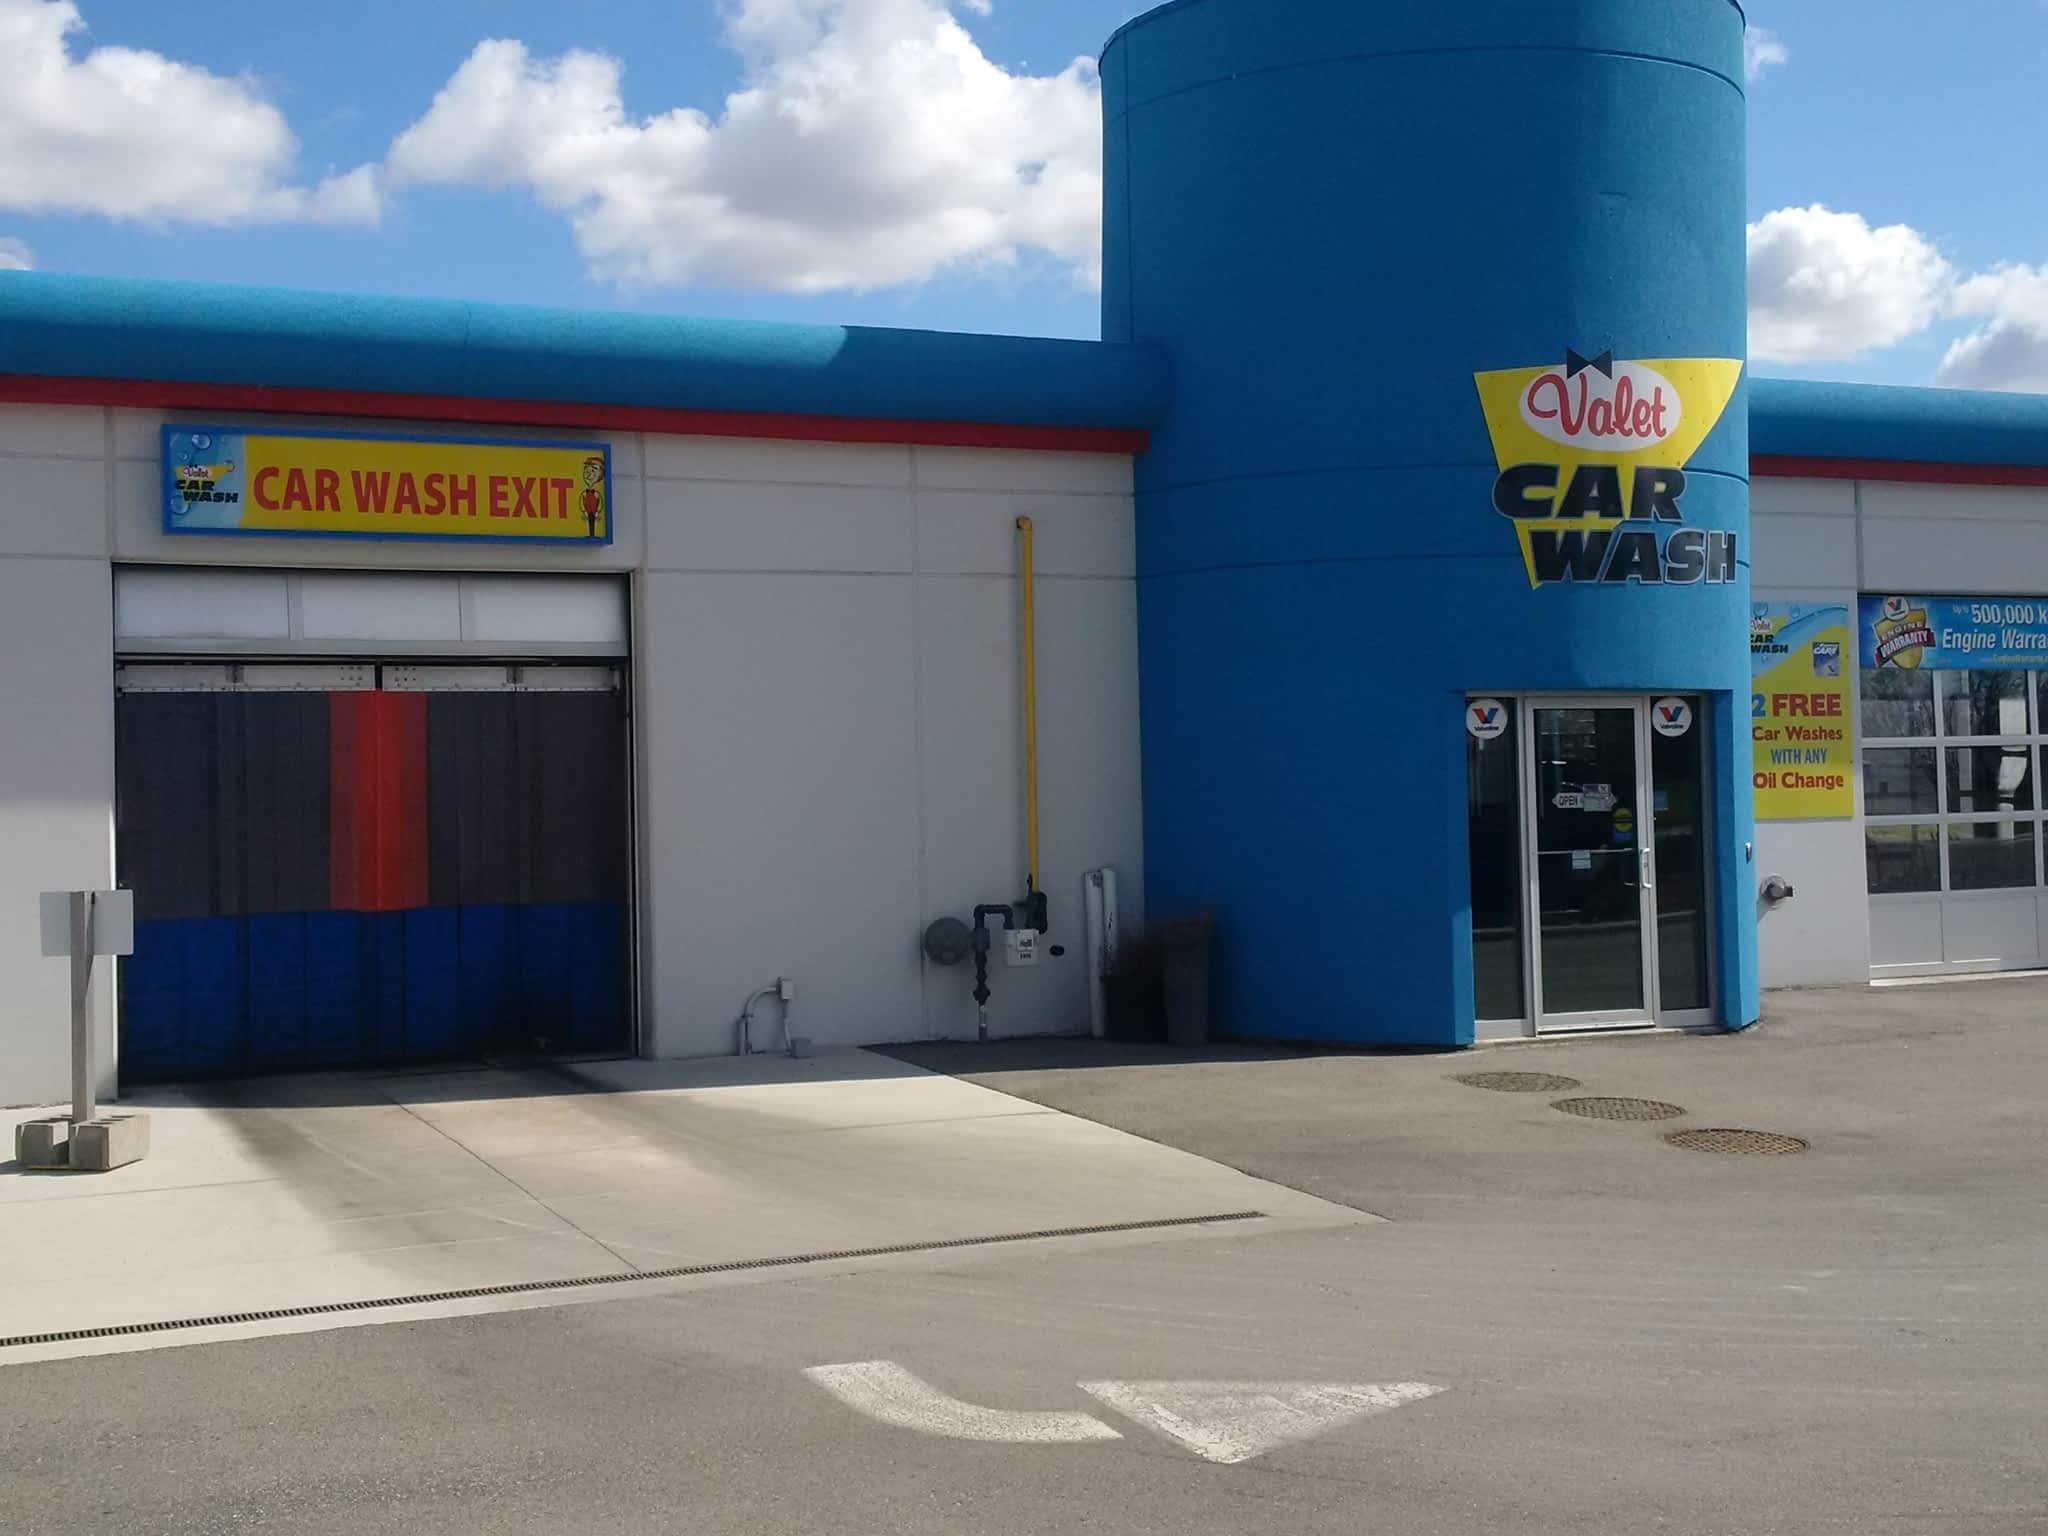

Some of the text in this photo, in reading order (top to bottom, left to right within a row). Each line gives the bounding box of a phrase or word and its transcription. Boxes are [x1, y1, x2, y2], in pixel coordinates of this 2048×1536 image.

[1527, 371, 1666, 437] Valet
[176, 480, 215, 490] CAR
[183, 491, 239, 503] WASH
[253, 466, 574, 519] CAR WASH EXIT
[1492, 462, 1687, 521] CAR
[1528, 528, 1737, 584] WASH
[1971, 604, 2034, 627] 500,000
[1880, 630, 1928, 658] WARRANTY
[1942, 628, 1997, 653] Engine
[1752, 693, 1842, 717] 2 FREE
[1752, 726, 1843, 741] Car Washes
[1771, 748, 1827, 764] WITH ANY
[1753, 772, 1844, 790] Oil Change
